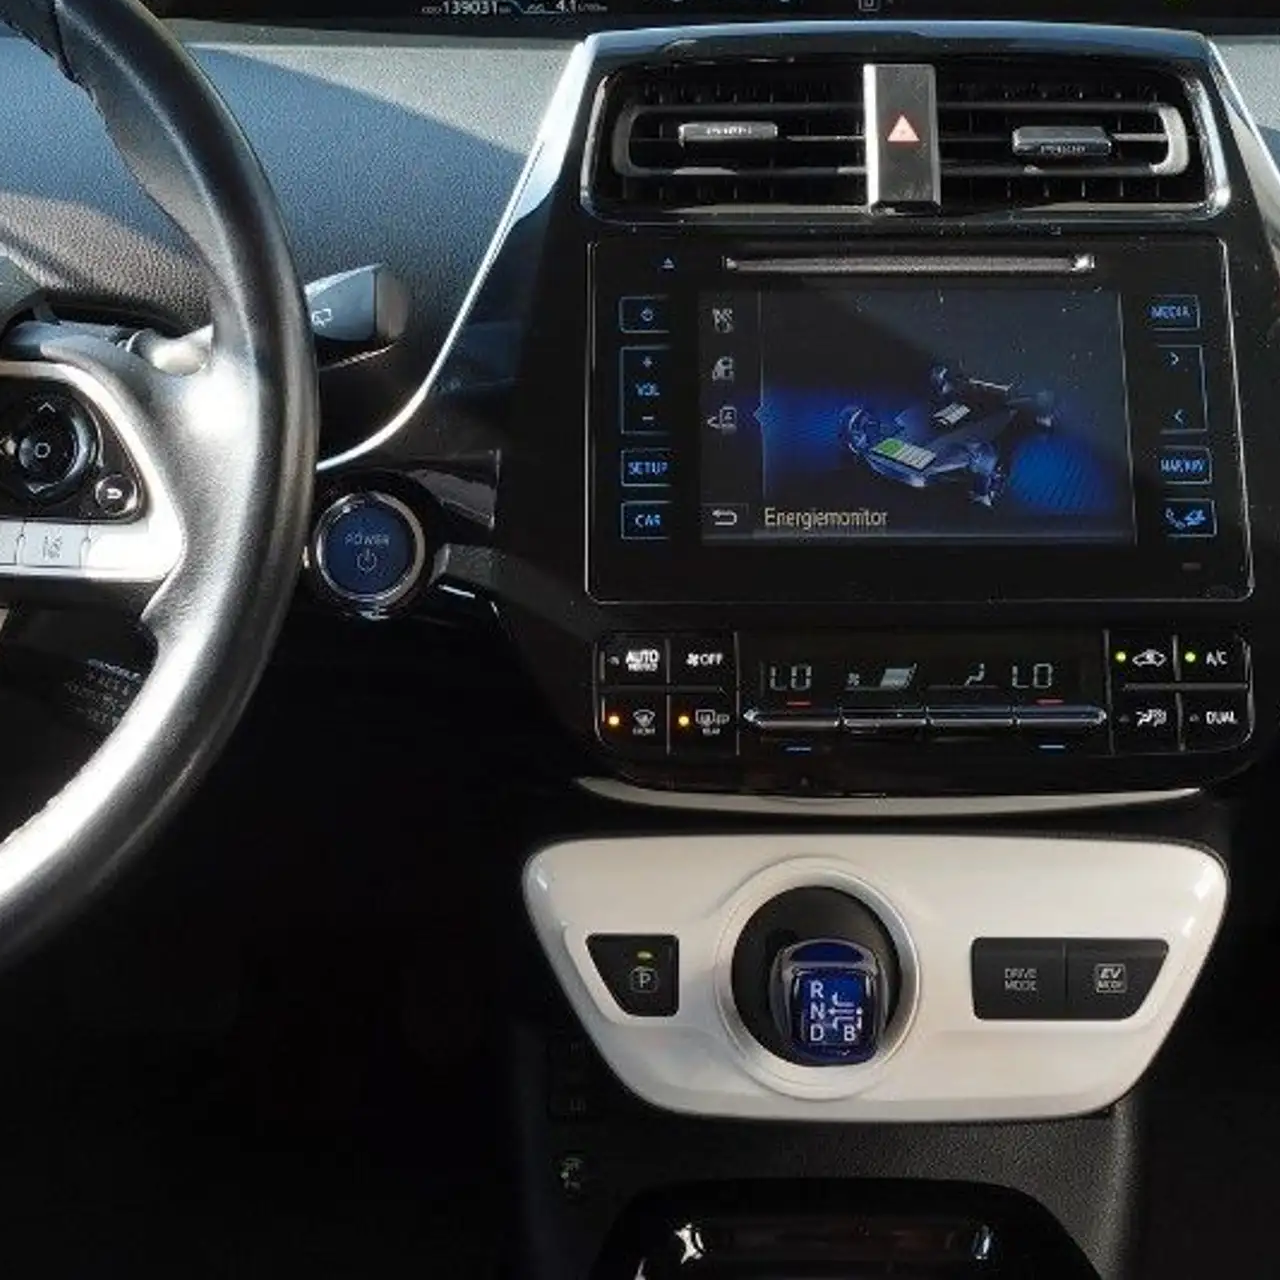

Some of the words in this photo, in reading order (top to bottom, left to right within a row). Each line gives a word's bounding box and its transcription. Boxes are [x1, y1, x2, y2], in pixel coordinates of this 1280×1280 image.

[443, 0, 497, 15] 139031
[627, 461, 669, 475] SETUP
[634, 514, 662, 528] CAR
[764, 508, 889, 530] Energiemonitor
[345, 533, 389, 546] POWER
[626, 650, 660, 663] AUTO
[700, 653, 723, 666] OFF
[1205, 649, 1228, 667] A/C
[1012, 663, 1053, 688] LO
[1205, 711, 1238, 724] DUAL
[1004, 968, 1037, 979] DRIVE
[1100, 967, 1122, 979] EV
[810, 981, 824, 999] R
[1004, 980, 1037, 991] MODE
[810, 1004, 825, 1020] N
[810, 1024, 825, 1042] D
[843, 1024, 857, 1042] B
